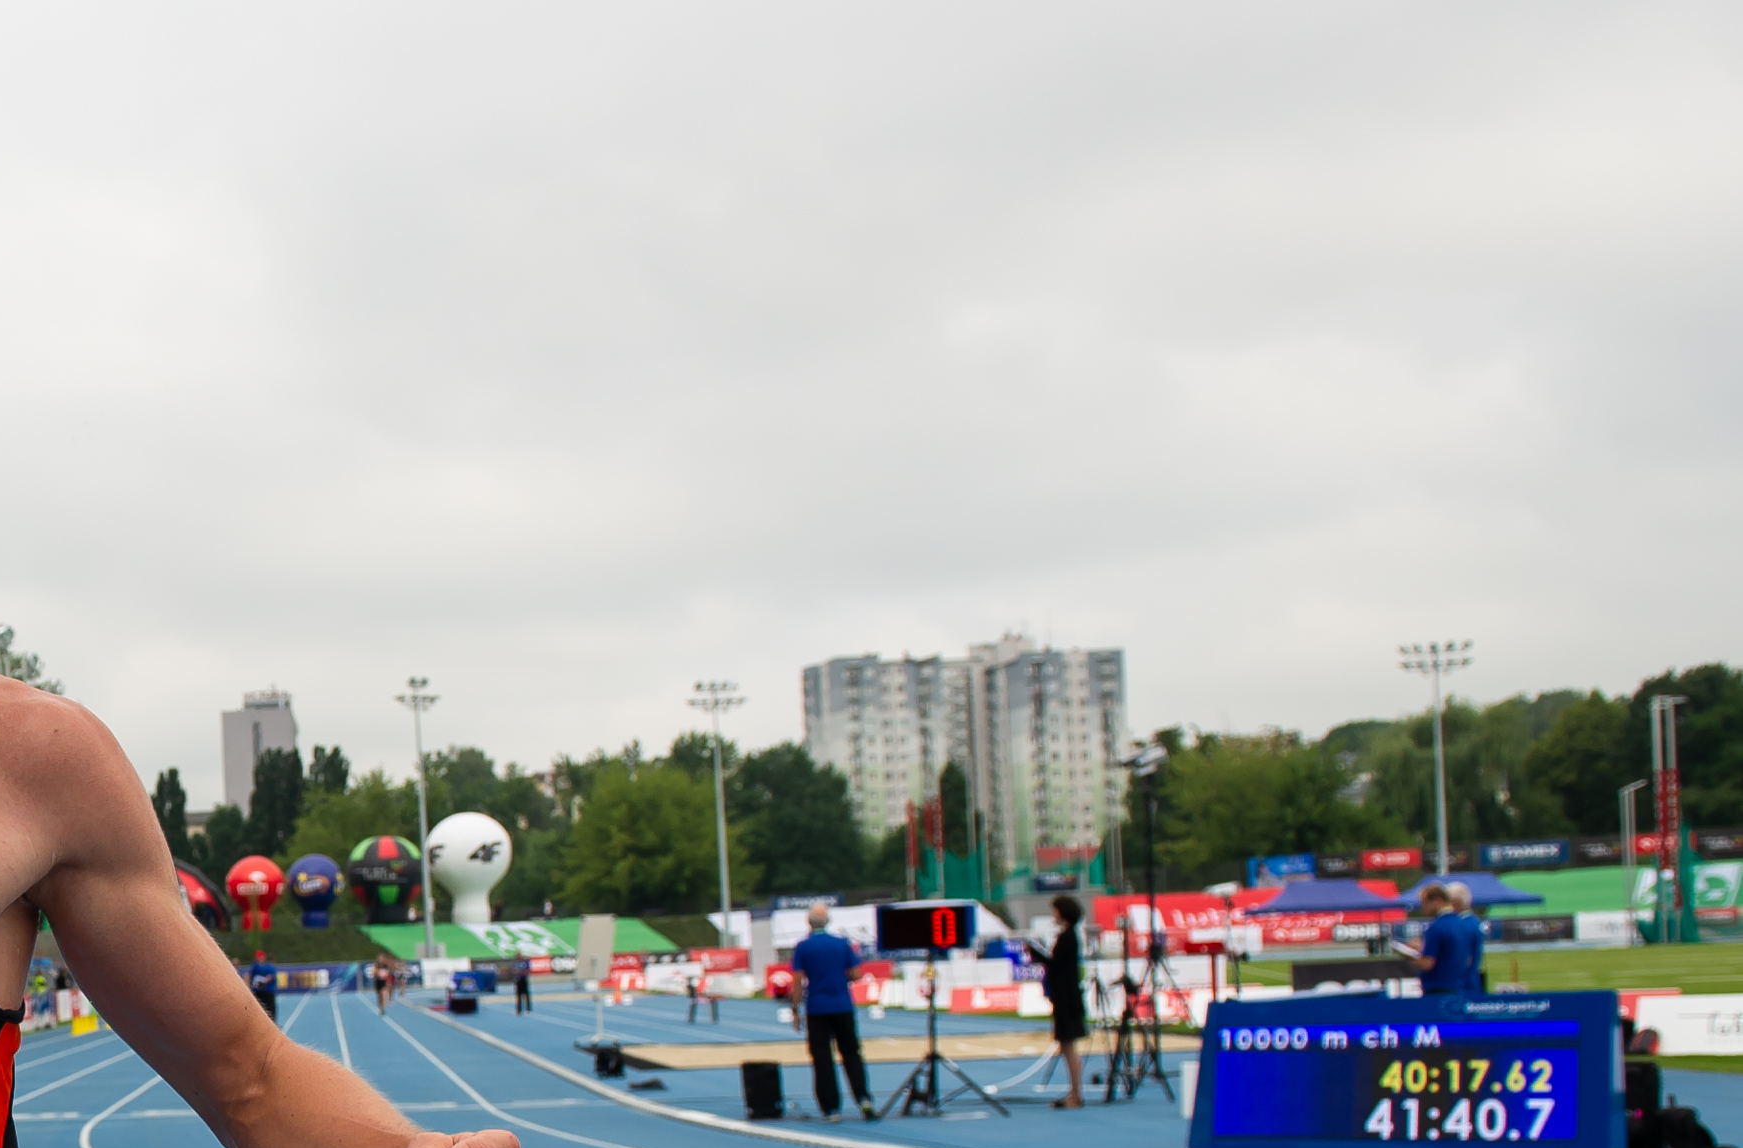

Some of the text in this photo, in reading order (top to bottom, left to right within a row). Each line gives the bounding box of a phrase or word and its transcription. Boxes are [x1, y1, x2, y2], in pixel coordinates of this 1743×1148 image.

[931, 907, 957, 948] 0
[1218, 1024, 1441, 1050] 10000 m ch M
[1379, 1059, 1553, 1093] 40:17.62
[1364, 1098, 1556, 1141] 41:40.7
